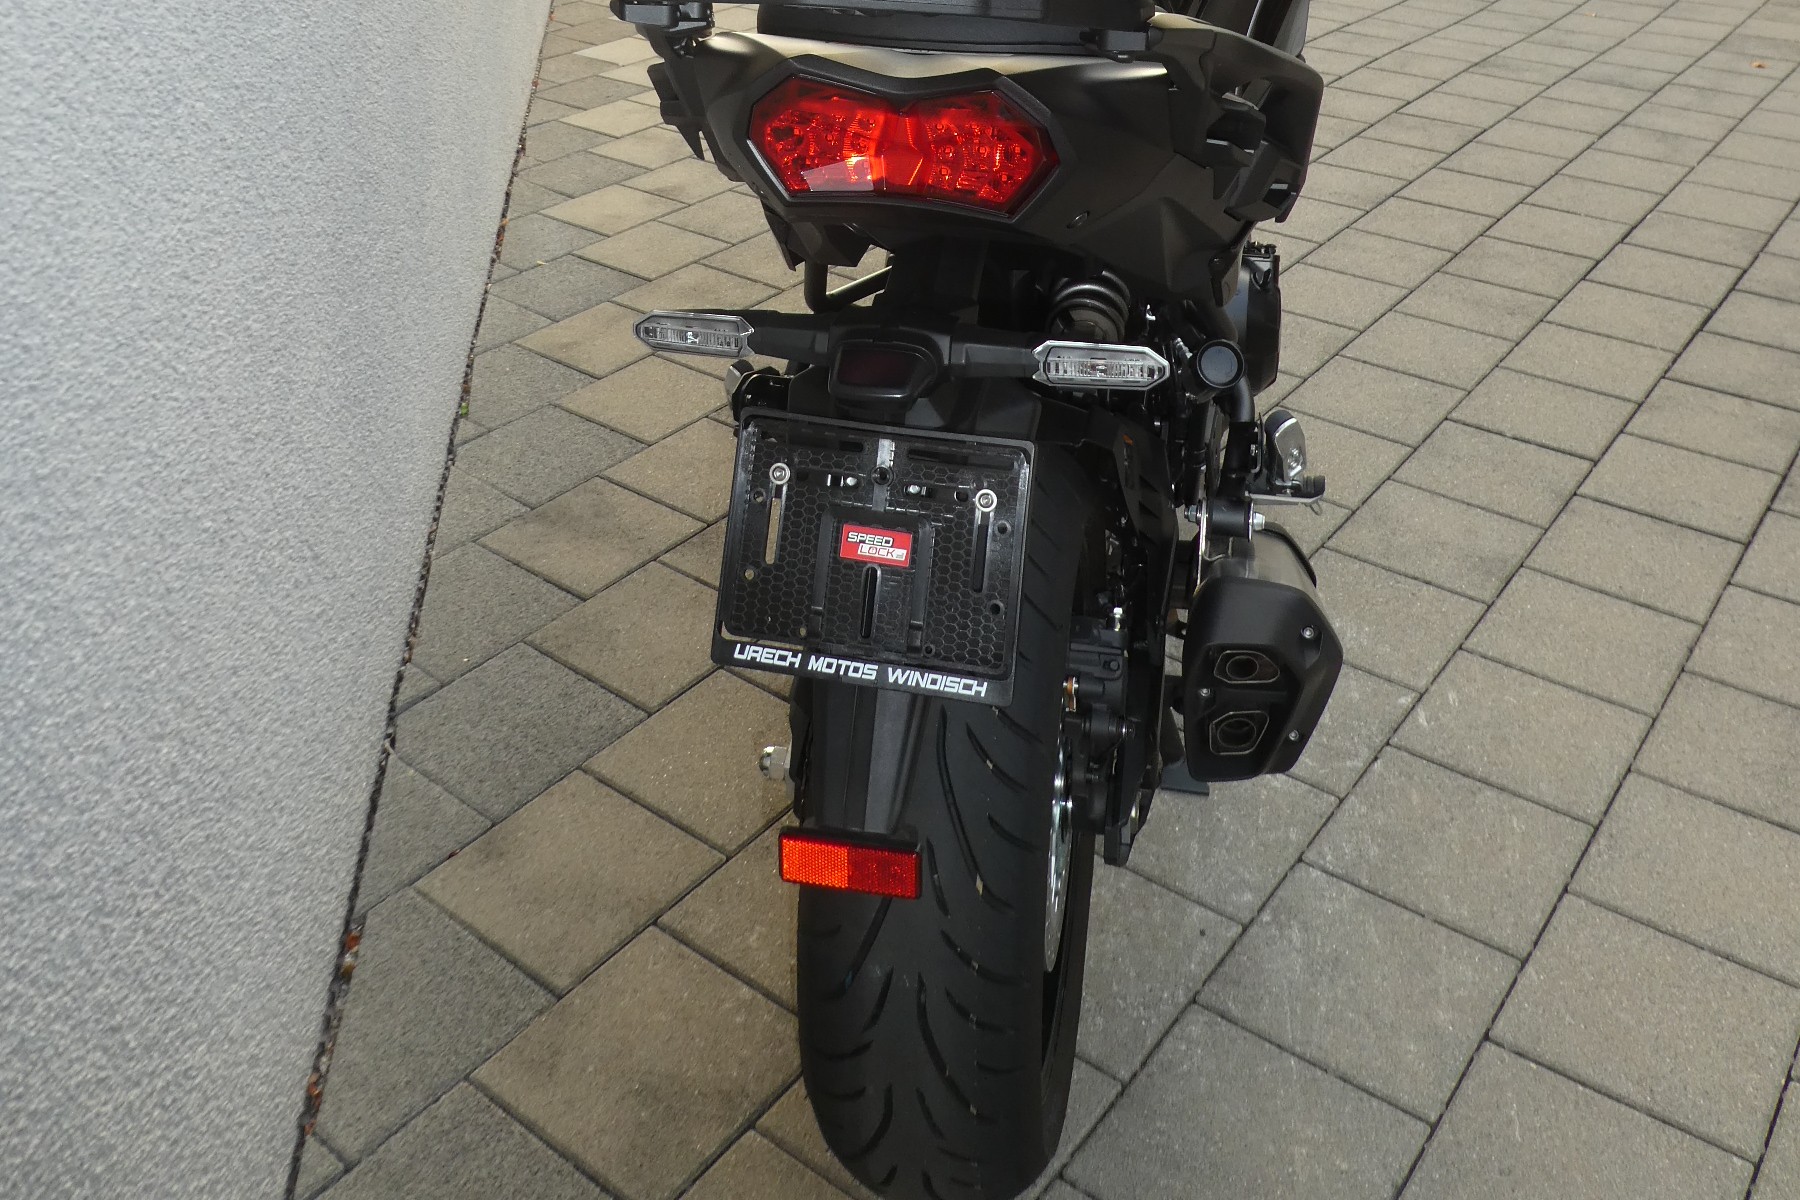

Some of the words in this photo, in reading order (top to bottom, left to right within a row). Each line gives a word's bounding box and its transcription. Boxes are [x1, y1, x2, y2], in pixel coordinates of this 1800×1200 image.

[847, 531, 893, 547] SPEED
[860, 544, 896, 558] LOCK
[733, 643, 802, 668] URECH
[807, 655, 878, 680] MOTOS
[887, 666, 988, 697] WINDISCH
